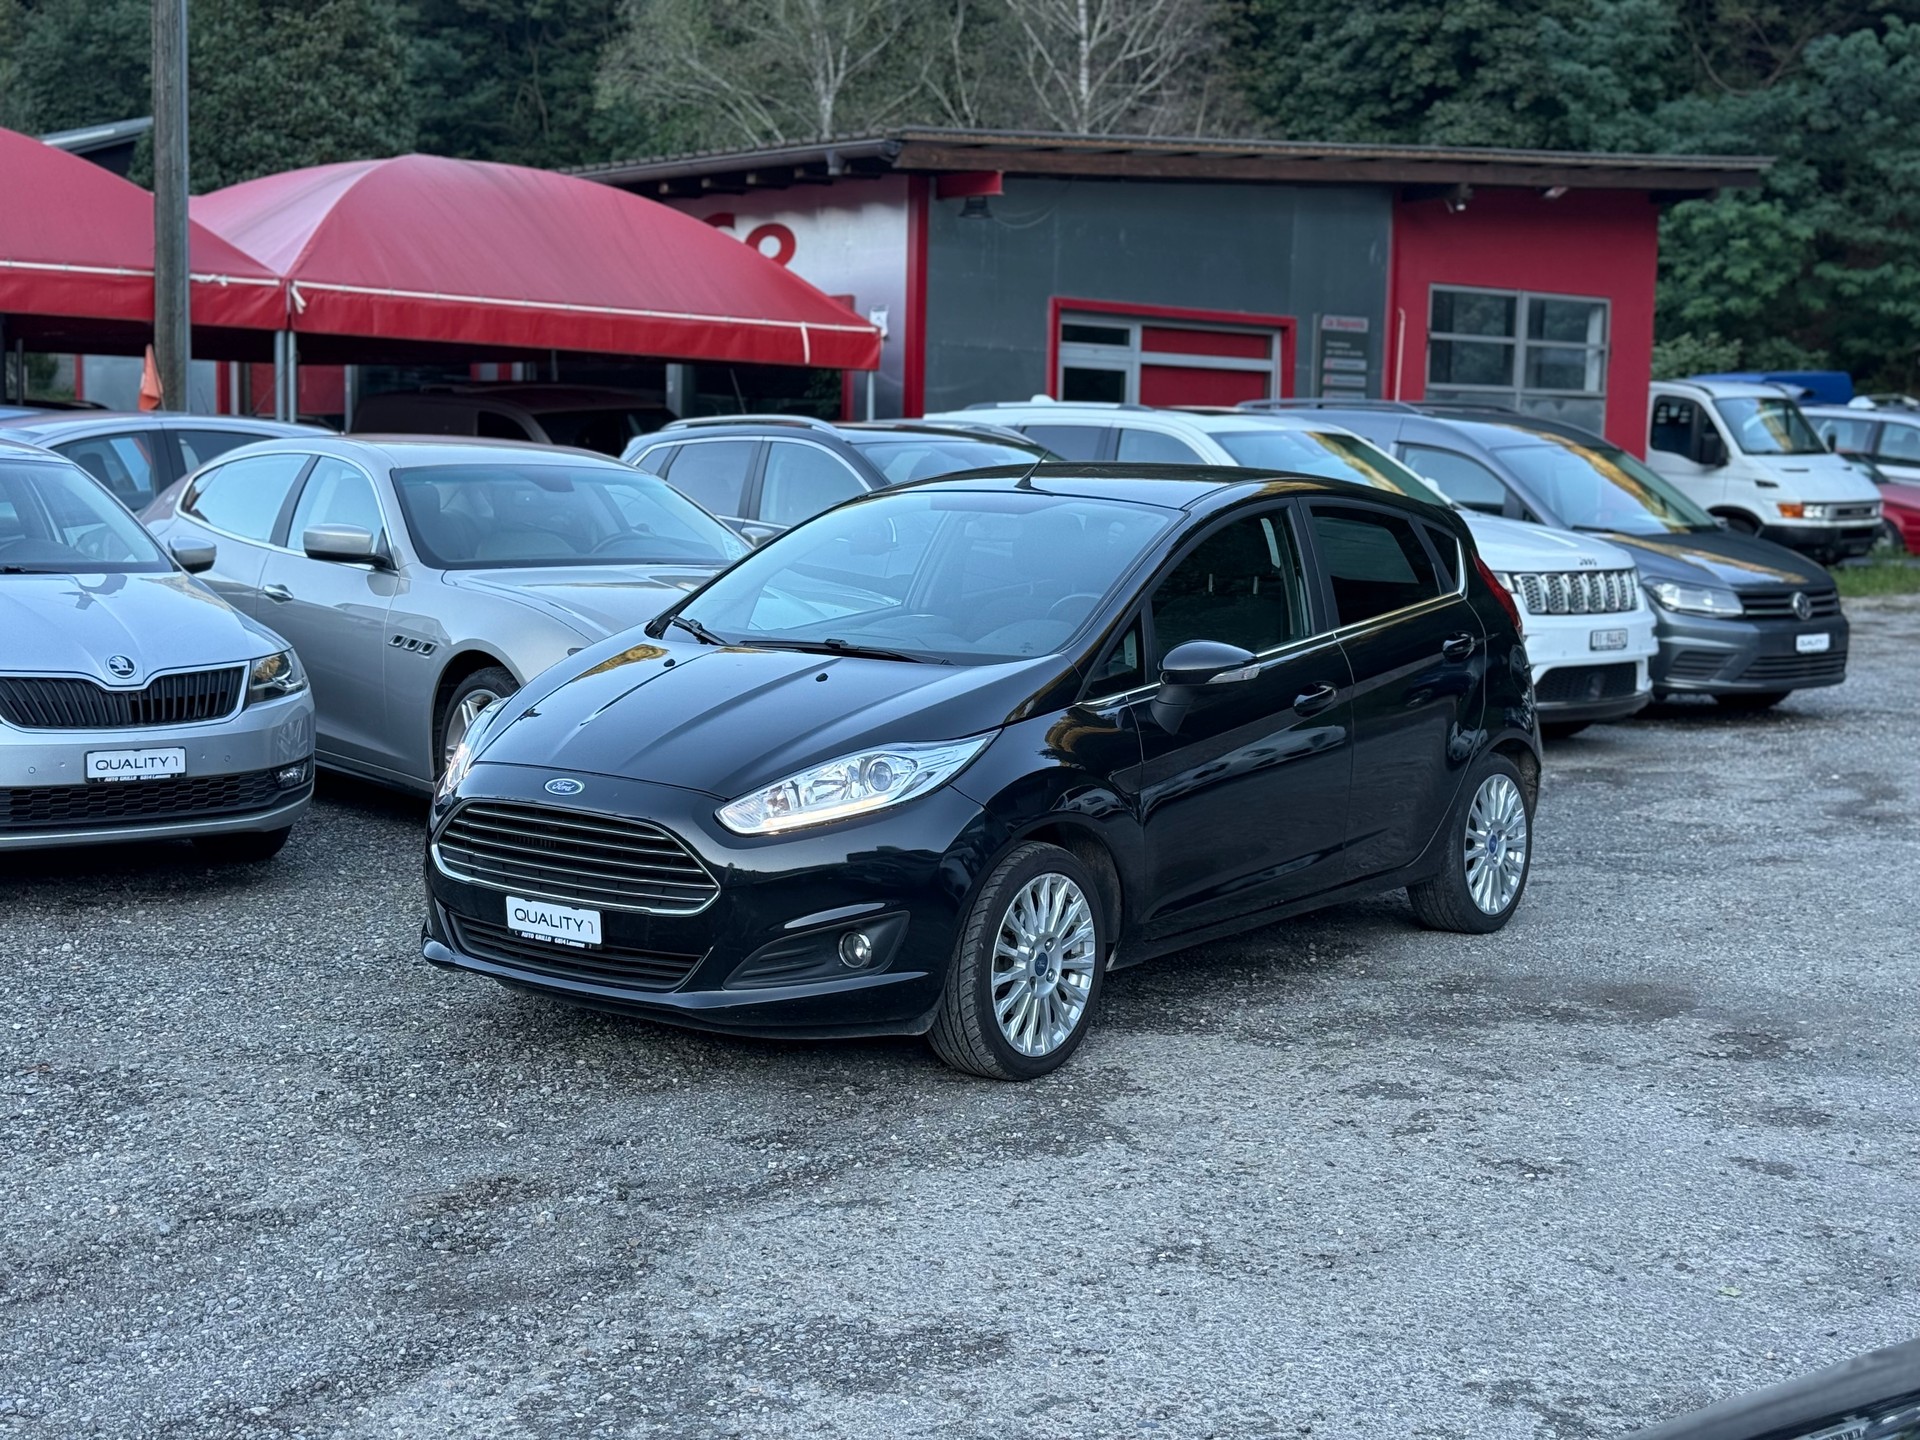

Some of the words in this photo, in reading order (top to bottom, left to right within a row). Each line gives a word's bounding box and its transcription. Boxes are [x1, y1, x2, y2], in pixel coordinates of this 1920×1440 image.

[95, 756, 169, 771] QUALITY
[552, 781, 575, 791] Ford
[514, 907, 584, 932] QUALITY
[521, 931, 534, 939] AUTO
